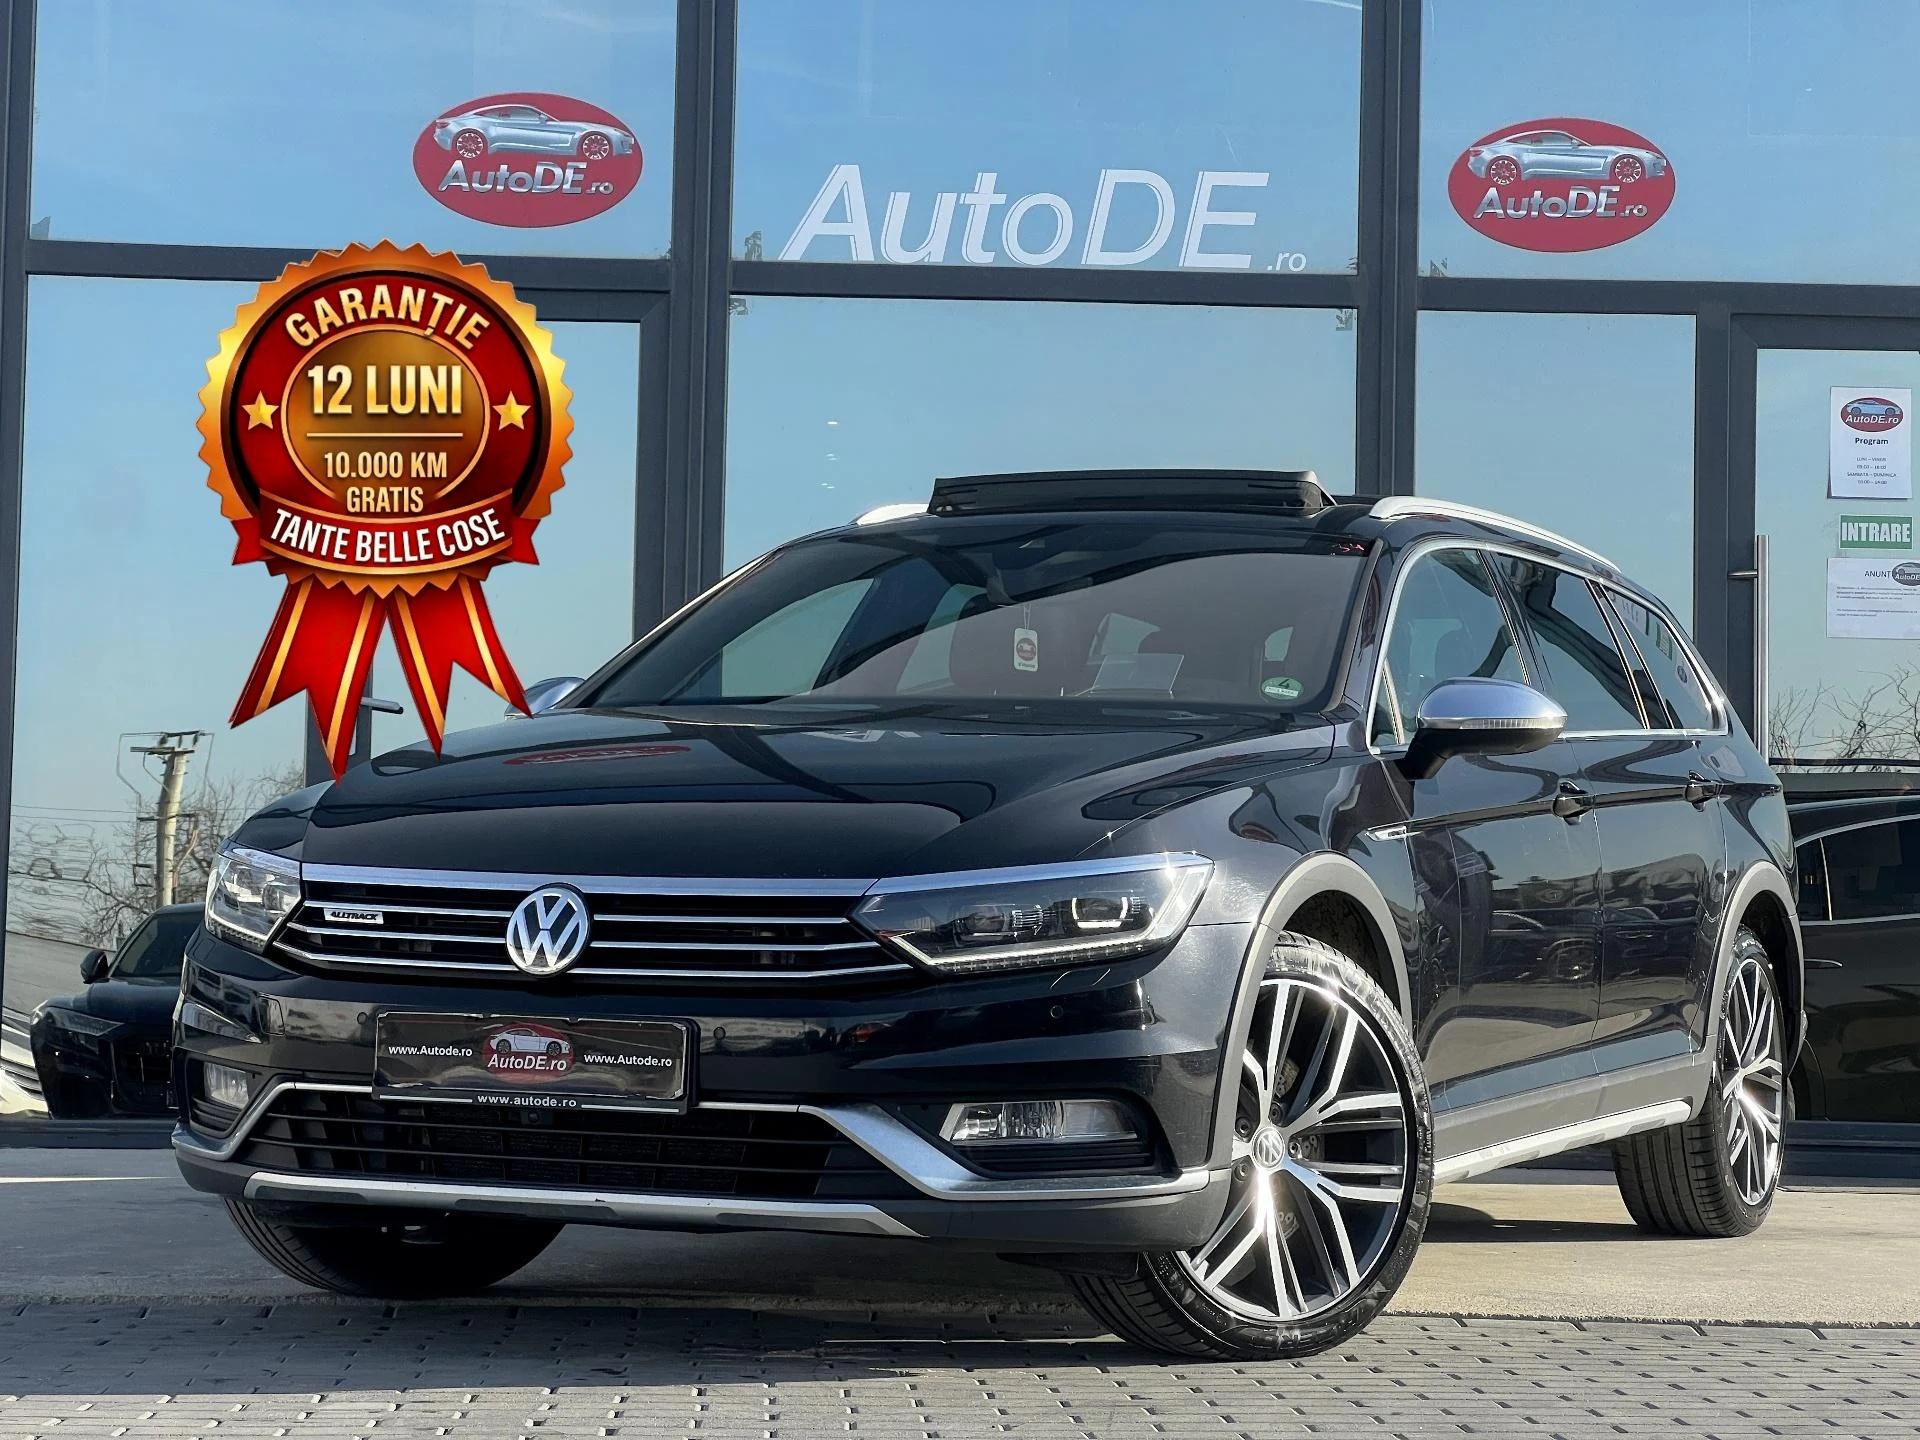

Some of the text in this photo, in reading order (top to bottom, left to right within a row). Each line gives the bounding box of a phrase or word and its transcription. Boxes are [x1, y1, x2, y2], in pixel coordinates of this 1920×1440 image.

[1845, 414, 1900, 424] AutoDE.ro
[1855, 437, 1889, 446] Program
[1841, 522, 1911, 543] INTRARE
[388, 1045, 473, 1057] www.Autode.ro
[487, 1053, 567, 1071] AutoDE.ro
[583, 1052, 673, 1067] www.Autode.ro
[477, 1093, 577, 1108] www.autode.ro
